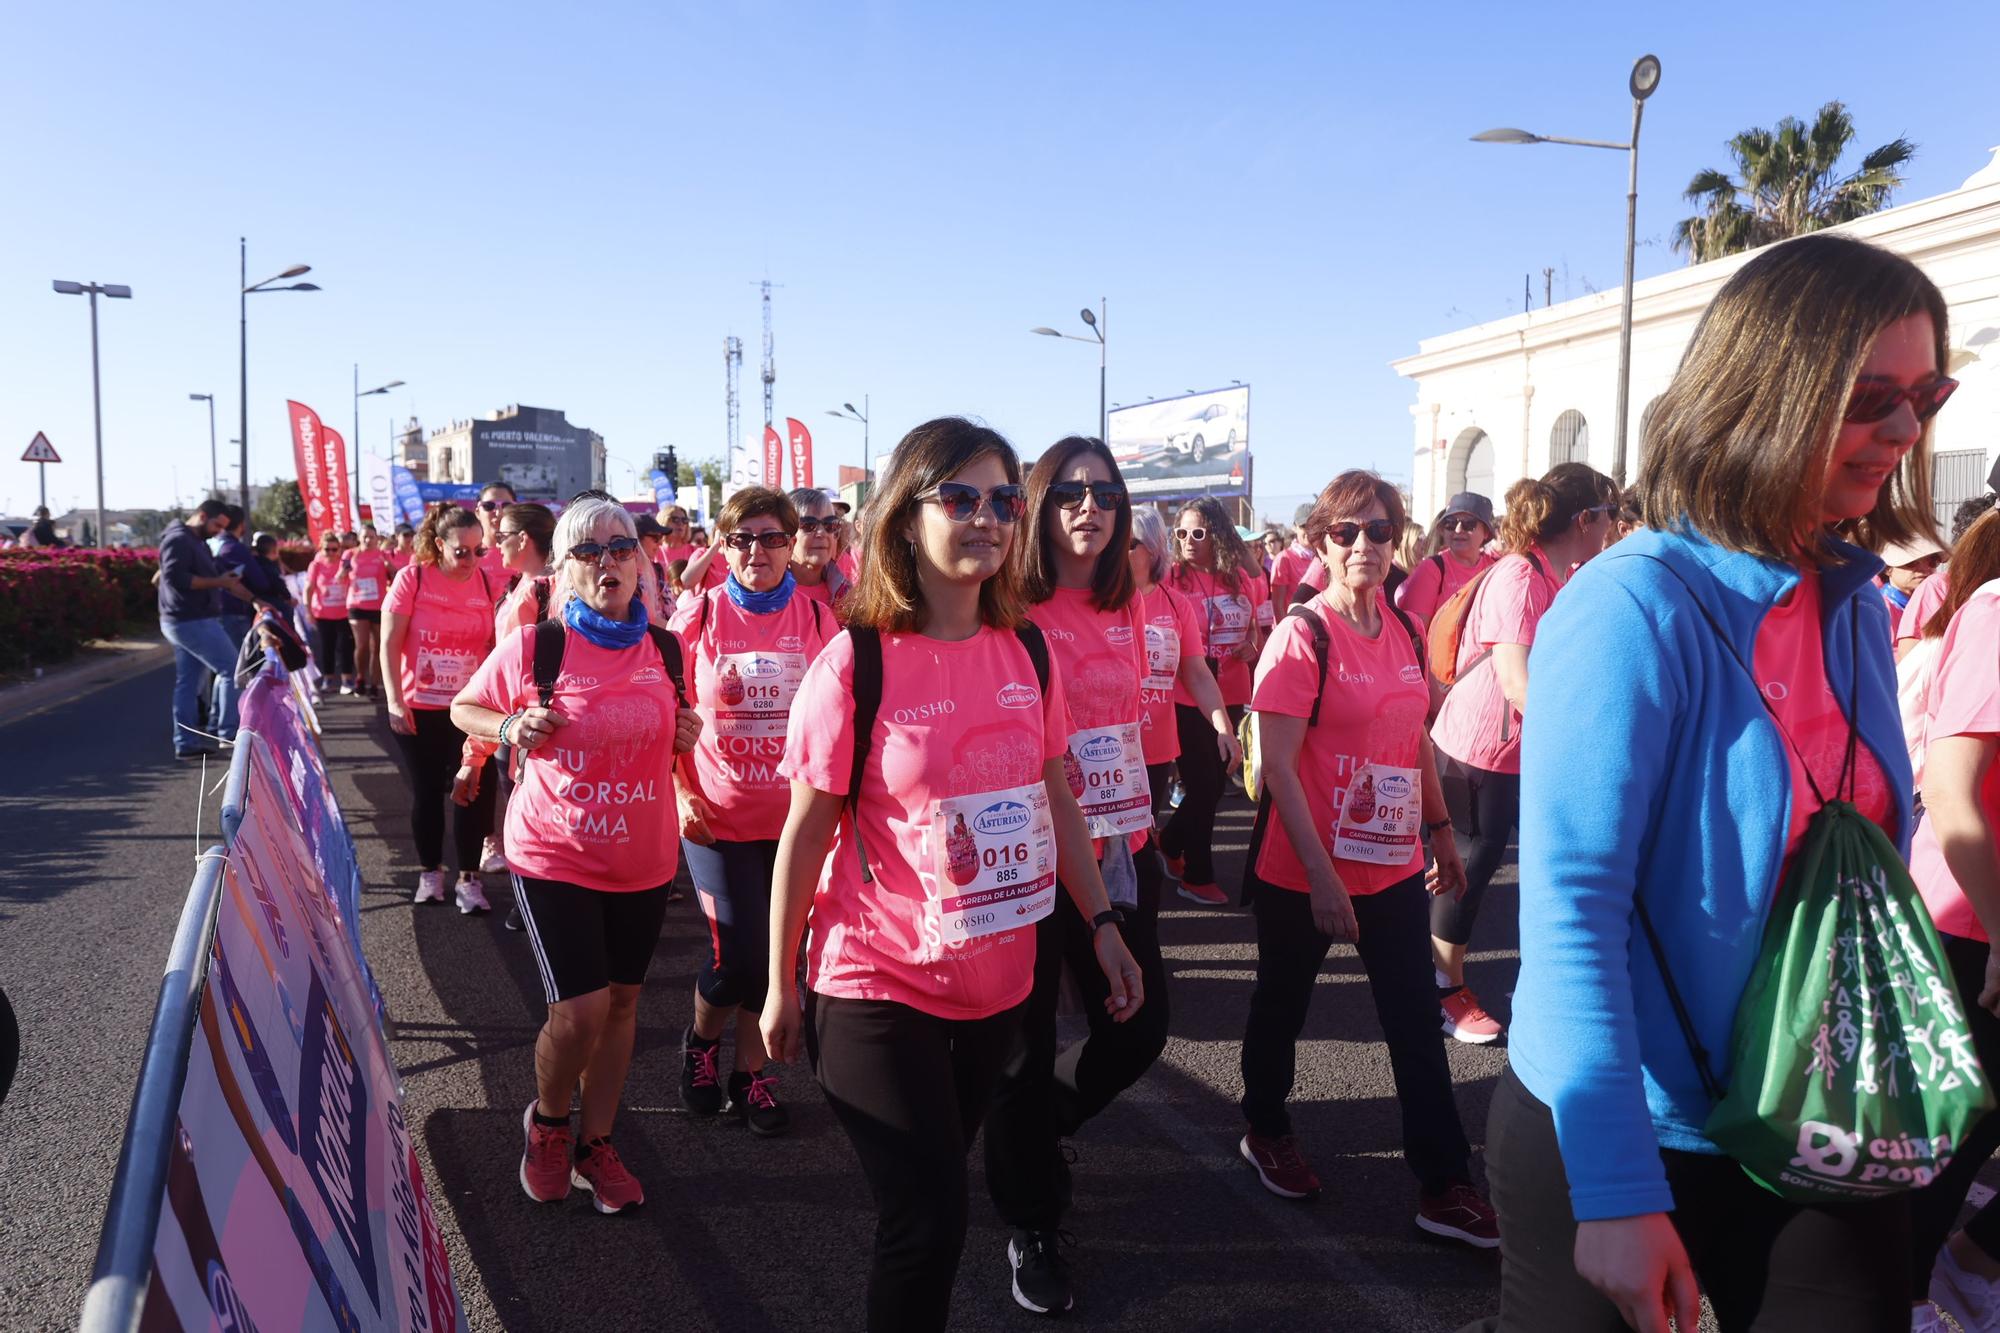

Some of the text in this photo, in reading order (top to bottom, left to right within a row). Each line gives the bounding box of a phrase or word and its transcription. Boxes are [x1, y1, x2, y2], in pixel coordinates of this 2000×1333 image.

[419, 629, 439, 643] TU
[1147, 651, 1160, 660] 16
[437, 675, 457, 684] 016
[747, 685, 779, 698] 016
[894, 699, 955, 724] OYSHO
[723, 723, 753, 731] OYSHO
[554, 747, 585, 773] TU
[1088, 768, 1124, 787] 016
[555, 776, 657, 805] DORSAL
[1101, 789, 1117, 800] 887
[1378, 805, 1404, 820] 016
[552, 804, 629, 837] SUMA
[978, 814, 1028, 830] ASTURIANA
[1383, 822, 1397, 832] 886
[1348, 831, 1377, 841] CARRERA
[983, 843, 1028, 867] 016
[1344, 844, 1374, 855] OYSHO
[997, 868, 1018, 883] 885
[956, 894, 993, 908] CARRERA
[994, 890, 1005, 899] DE
[1006, 888, 1016, 897] LA
[1017, 884, 1038, 894] MUJER
[1026, 896, 1052, 914] Santander
[954, 912, 995, 930] OYSHO
[1858, 1158, 1951, 1188] pop
